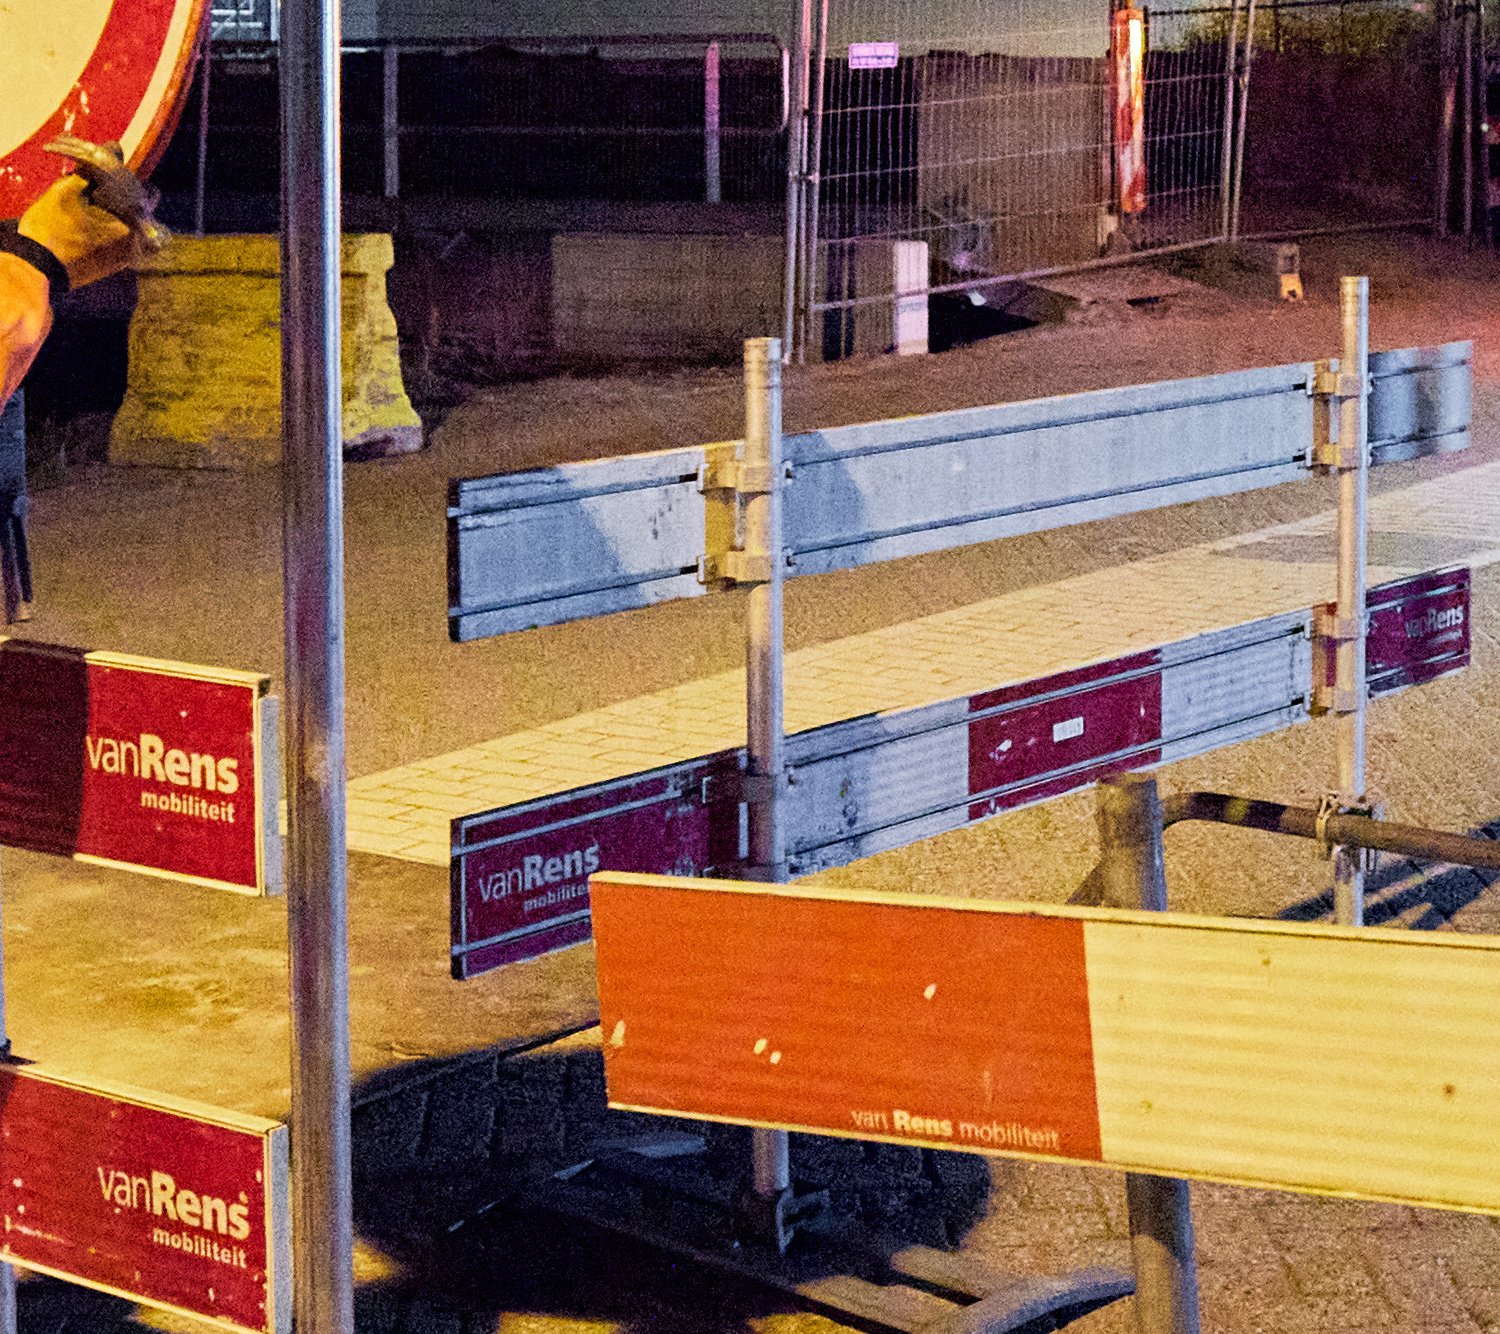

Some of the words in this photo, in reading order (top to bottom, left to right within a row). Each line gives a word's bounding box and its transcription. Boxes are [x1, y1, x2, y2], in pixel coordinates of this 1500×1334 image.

[86, 733, 240, 794] vanRens
[141, 792, 235, 823] mobiliteit
[478, 846, 600, 902] vanRens
[523, 884, 589, 912] mobilite
[851, 1110, 888, 1130] van
[893, 1109, 953, 1137] Rens
[959, 1120, 1060, 1151] mobiliteit
[97, 1166, 250, 1240] vanRens
[153, 1227, 247, 1269] mobiliteit
